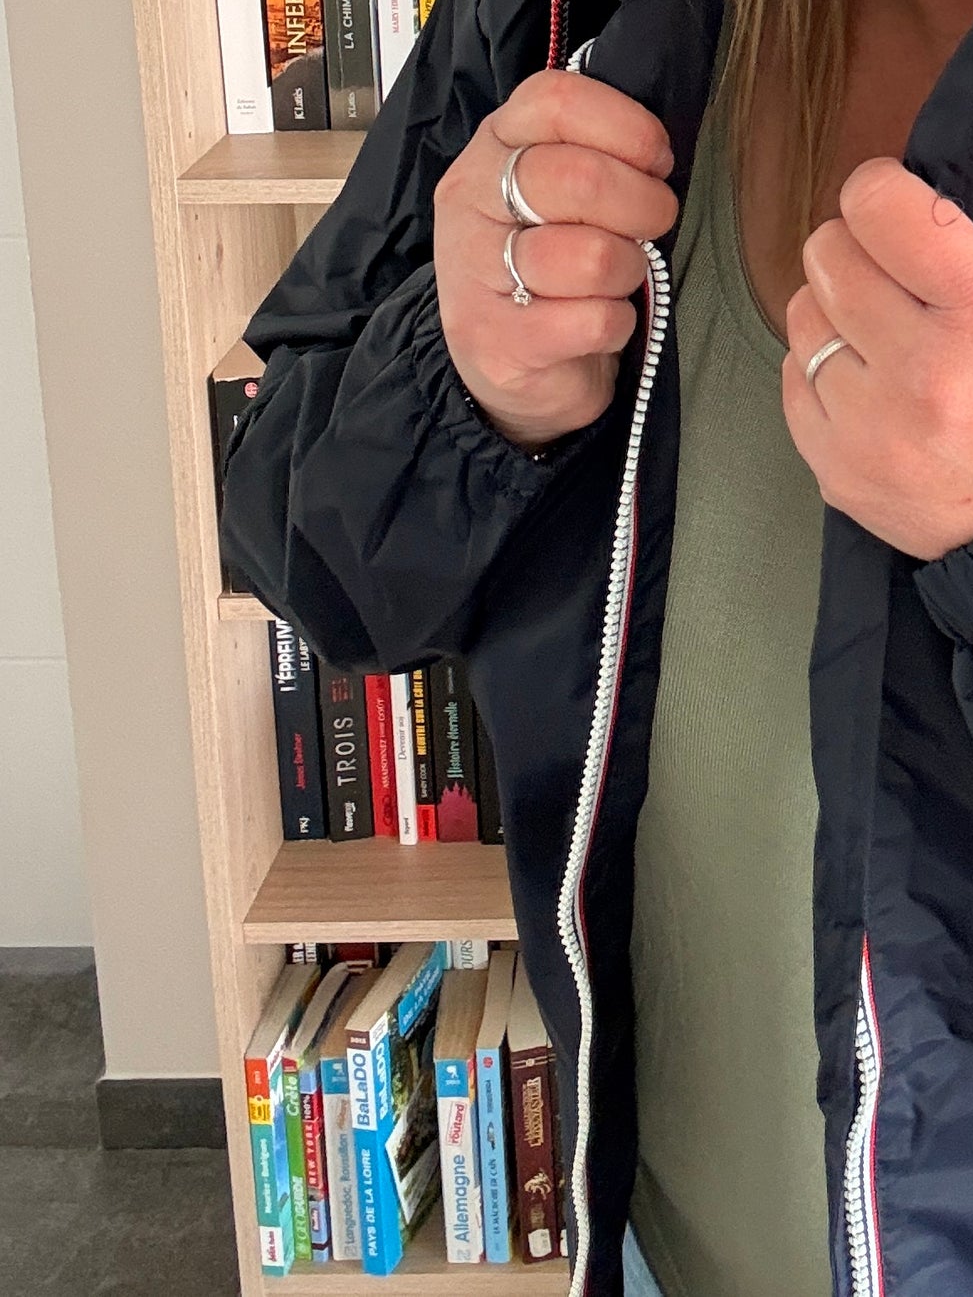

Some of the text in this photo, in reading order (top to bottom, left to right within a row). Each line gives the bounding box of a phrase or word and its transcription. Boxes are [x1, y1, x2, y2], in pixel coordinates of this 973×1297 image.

[345, 33, 355, 49] LA
[391, 12, 400, 33] MARY
[300, 661, 310, 671] LE
[415, 699, 425, 724] SUR LA
[333, 717, 357, 786] TROIS
[379, 738, 390, 789] ASSAISONNEZ
[397, 730, 407, 760] Devenir
[444, 702, 464, 778] Histoire éternelle
[353, 1053, 370, 1126] BaLaDO
[303, 1095, 317, 1184] NEW YORK 100%
[452, 1104, 464, 1144] routard
[338, 1134, 350, 1182] Roussillon
[361, 1149, 378, 1256] PAYS DE LA LOIRE
[453, 1155, 470, 1243] Allemagne
